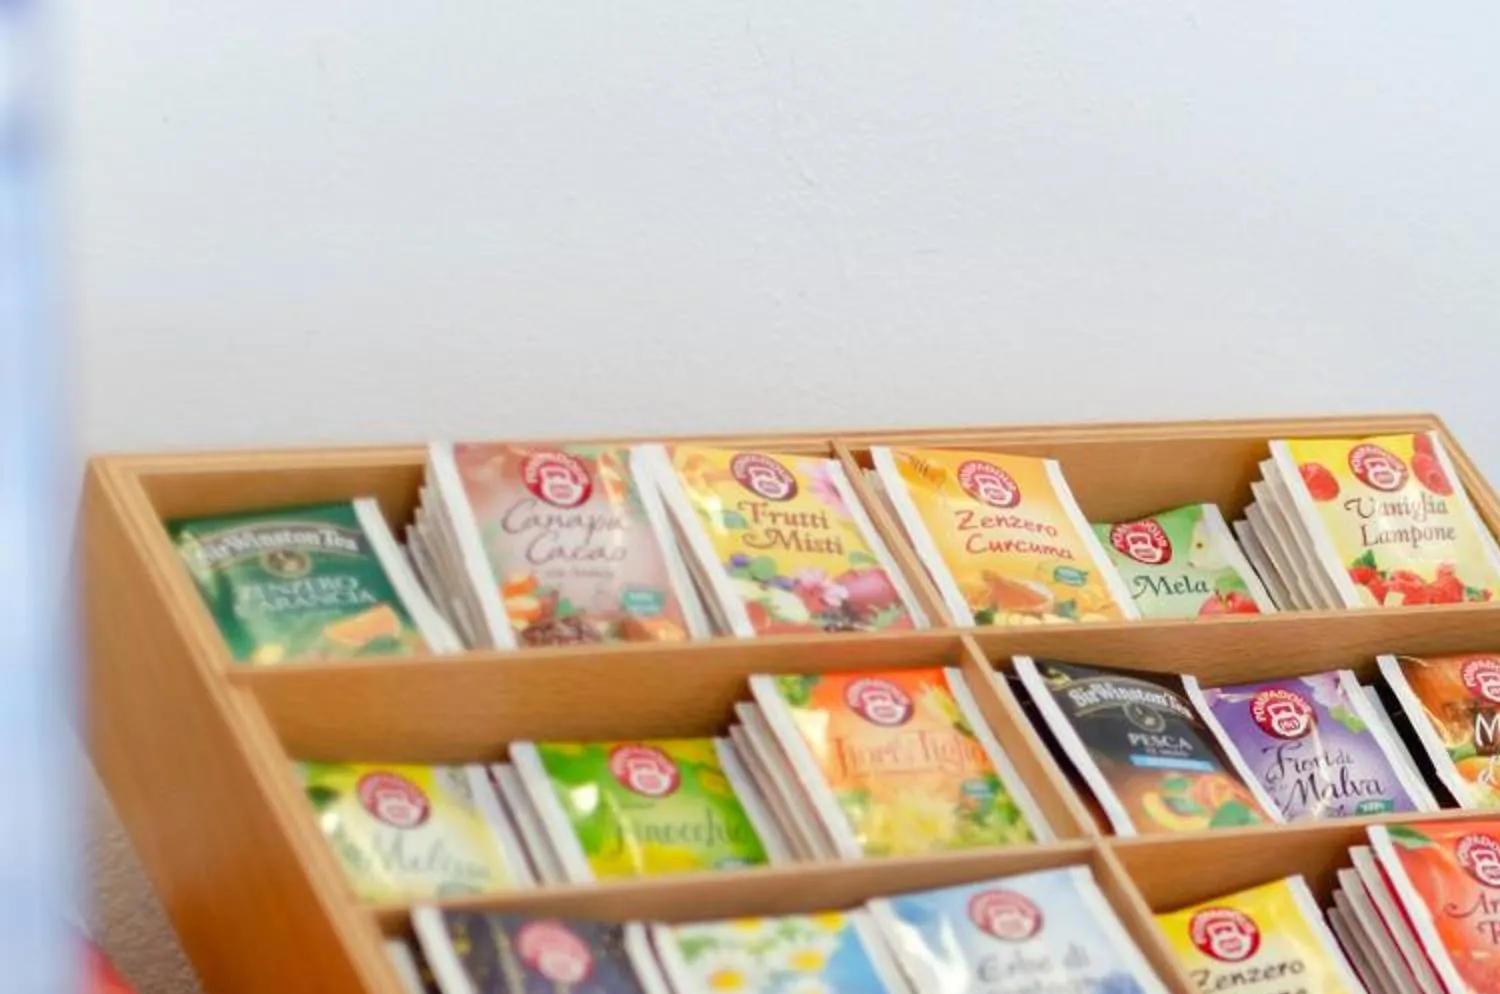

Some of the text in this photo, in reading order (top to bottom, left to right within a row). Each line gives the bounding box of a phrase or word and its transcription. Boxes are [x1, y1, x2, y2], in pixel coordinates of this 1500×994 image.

[737, 500, 830, 530] Frutti
[954, 509, 1058, 538] Zenzero
[525, 530, 628, 566] Cacao
[742, 528, 845, 556] Misti
[965, 533, 1076, 562] Curcuma
[1360, 524, 1457, 549] Lampone
[1132, 573, 1210, 600] Mela
[1126, 732, 1194, 751] PESCA
[1281, 766, 1386, 817] Malva
